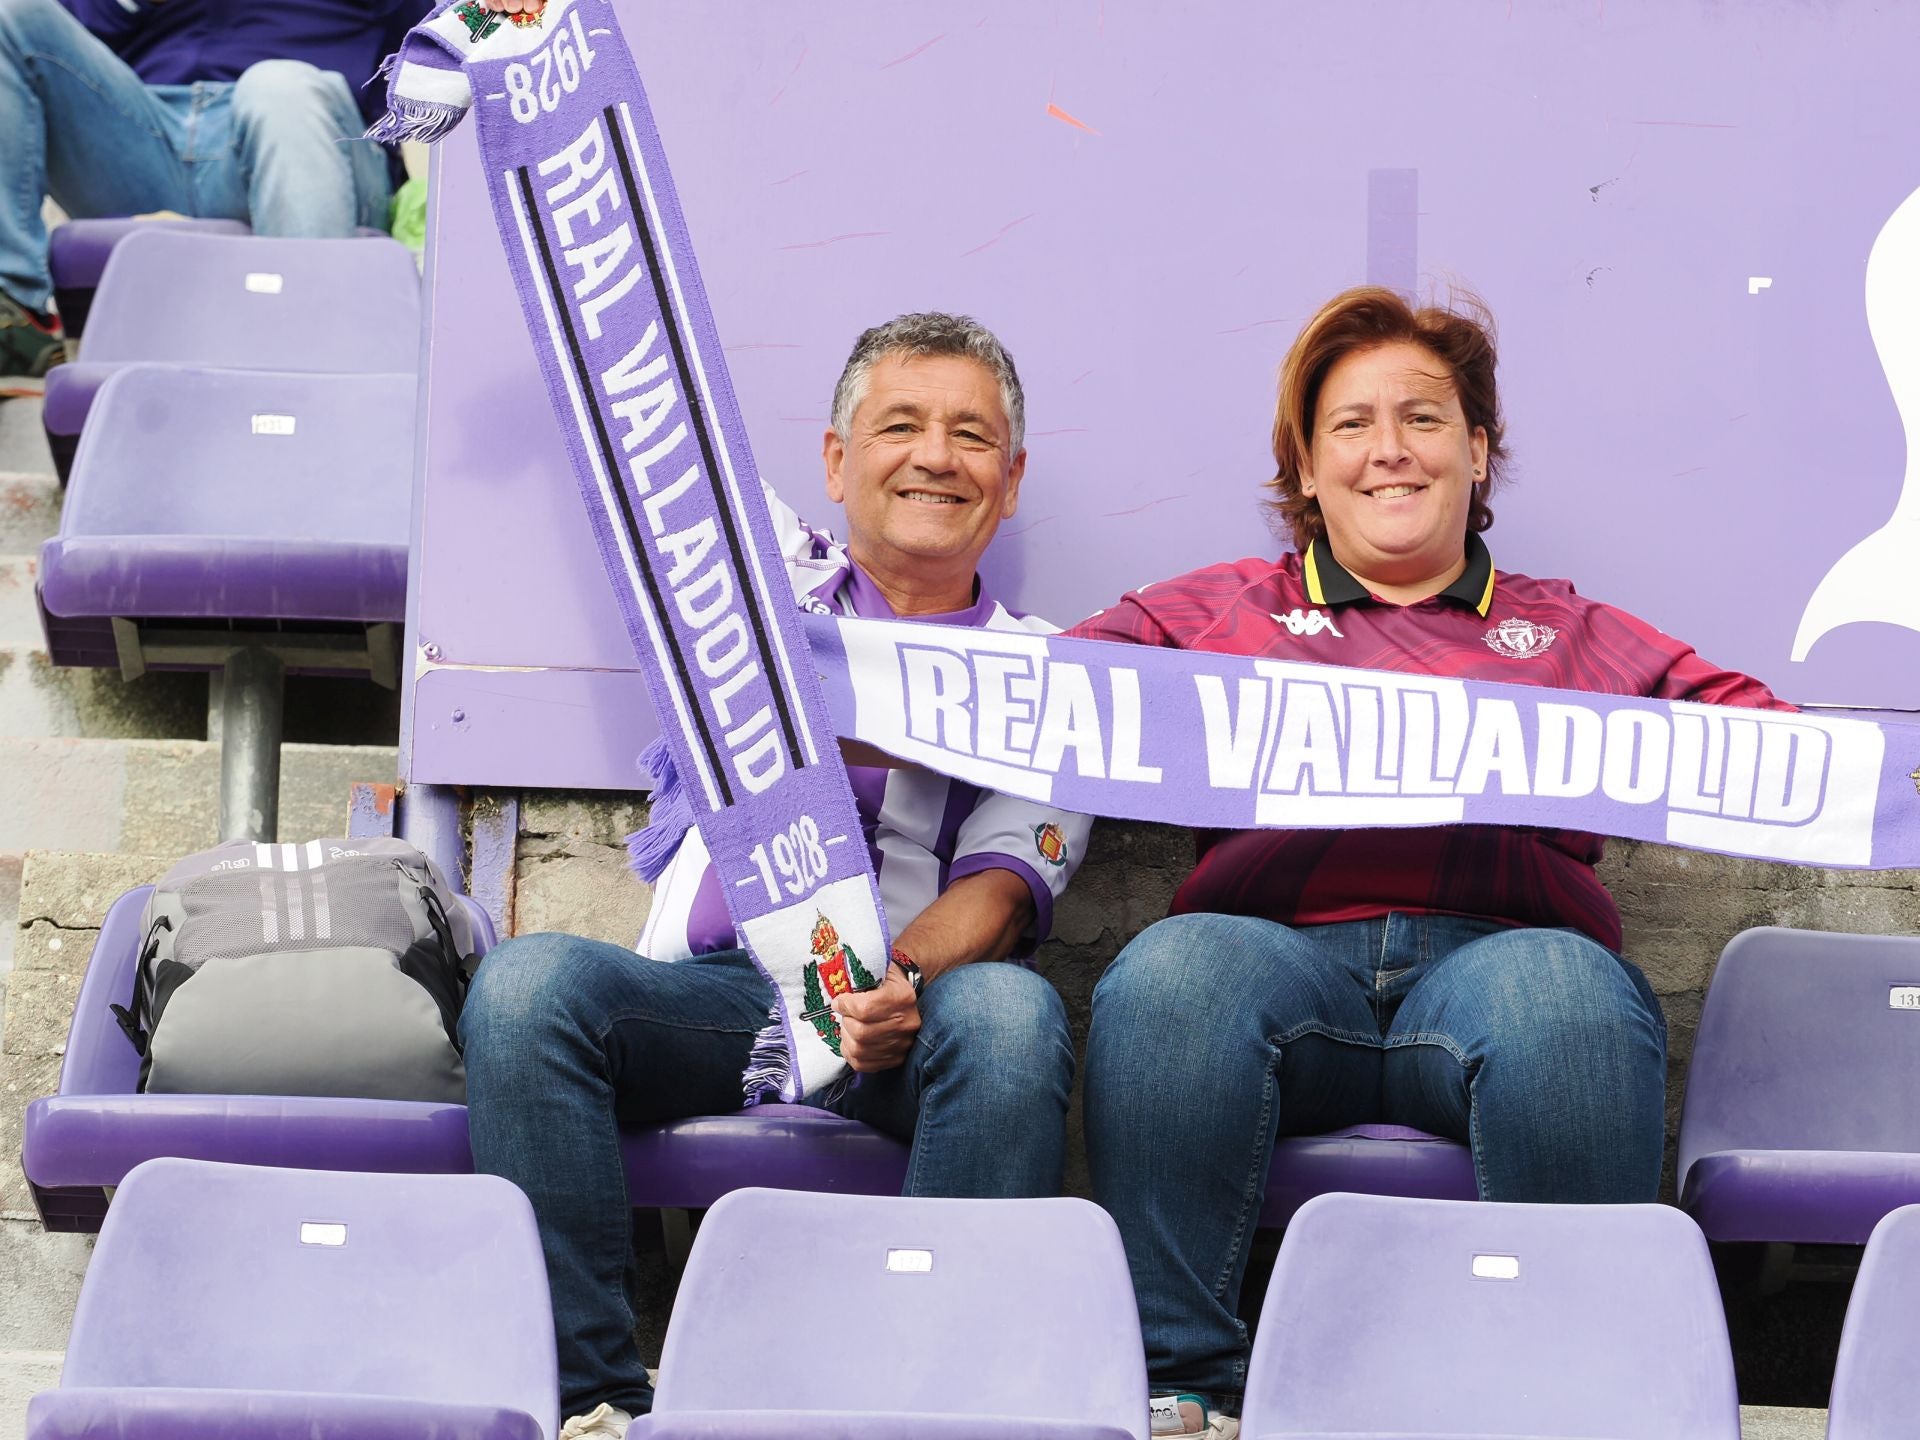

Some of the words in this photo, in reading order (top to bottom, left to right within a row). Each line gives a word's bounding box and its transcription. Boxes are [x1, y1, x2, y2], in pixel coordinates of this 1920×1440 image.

[538, 117, 643, 341] REAL
[601, 320, 786, 795] VALLADOLID
[899, 644, 1162, 784] REAL
[1193, 675, 1832, 826] VALLADOLID
